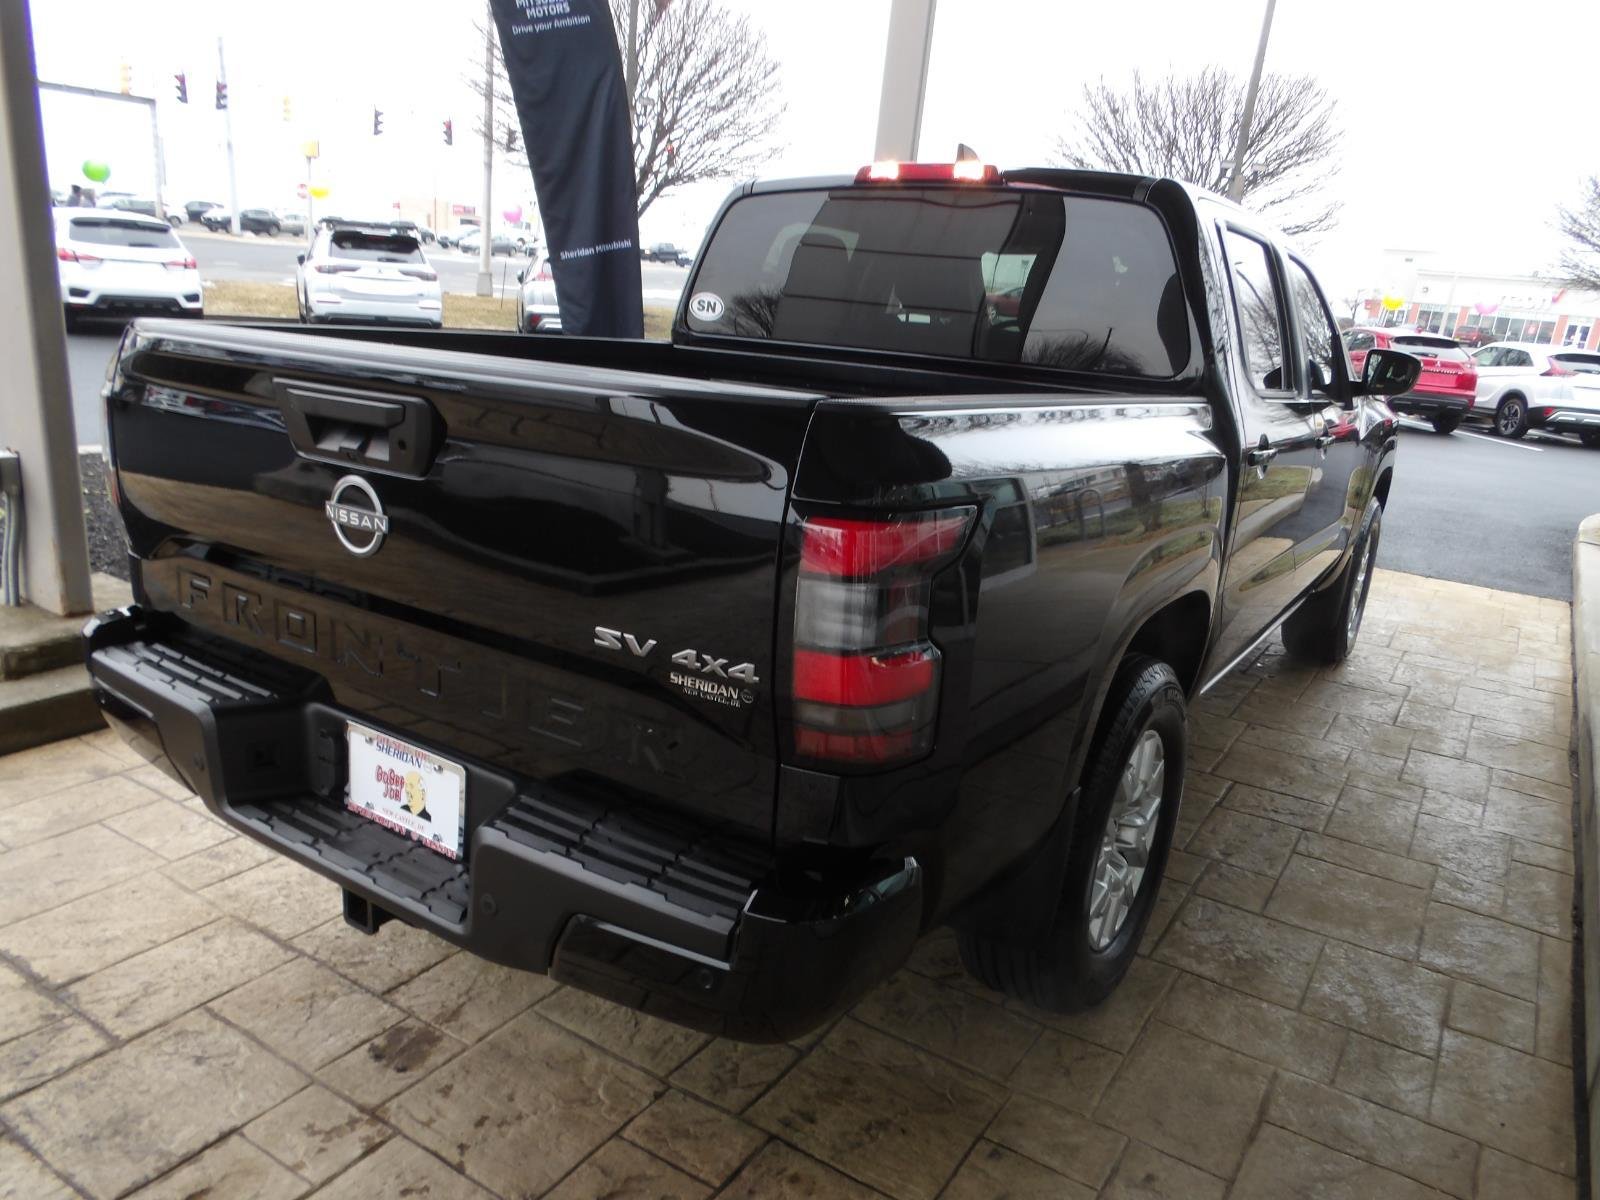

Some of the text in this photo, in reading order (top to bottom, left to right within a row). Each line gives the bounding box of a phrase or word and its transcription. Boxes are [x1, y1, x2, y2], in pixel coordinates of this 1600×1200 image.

[526, 2, 570, 19] MOTORS
[511, 15, 591, 35] Drive your Ambition
[560, 247, 595, 260] Sheridan
[697, 301, 717, 313] SN
[326, 504, 387, 533] NISSAN
[593, 626, 657, 658] SV
[177, 567, 688, 783] FRONTIER
[670, 672, 739, 699] SHERIDAN
[376, 743, 422, 768] SHERIDAN
